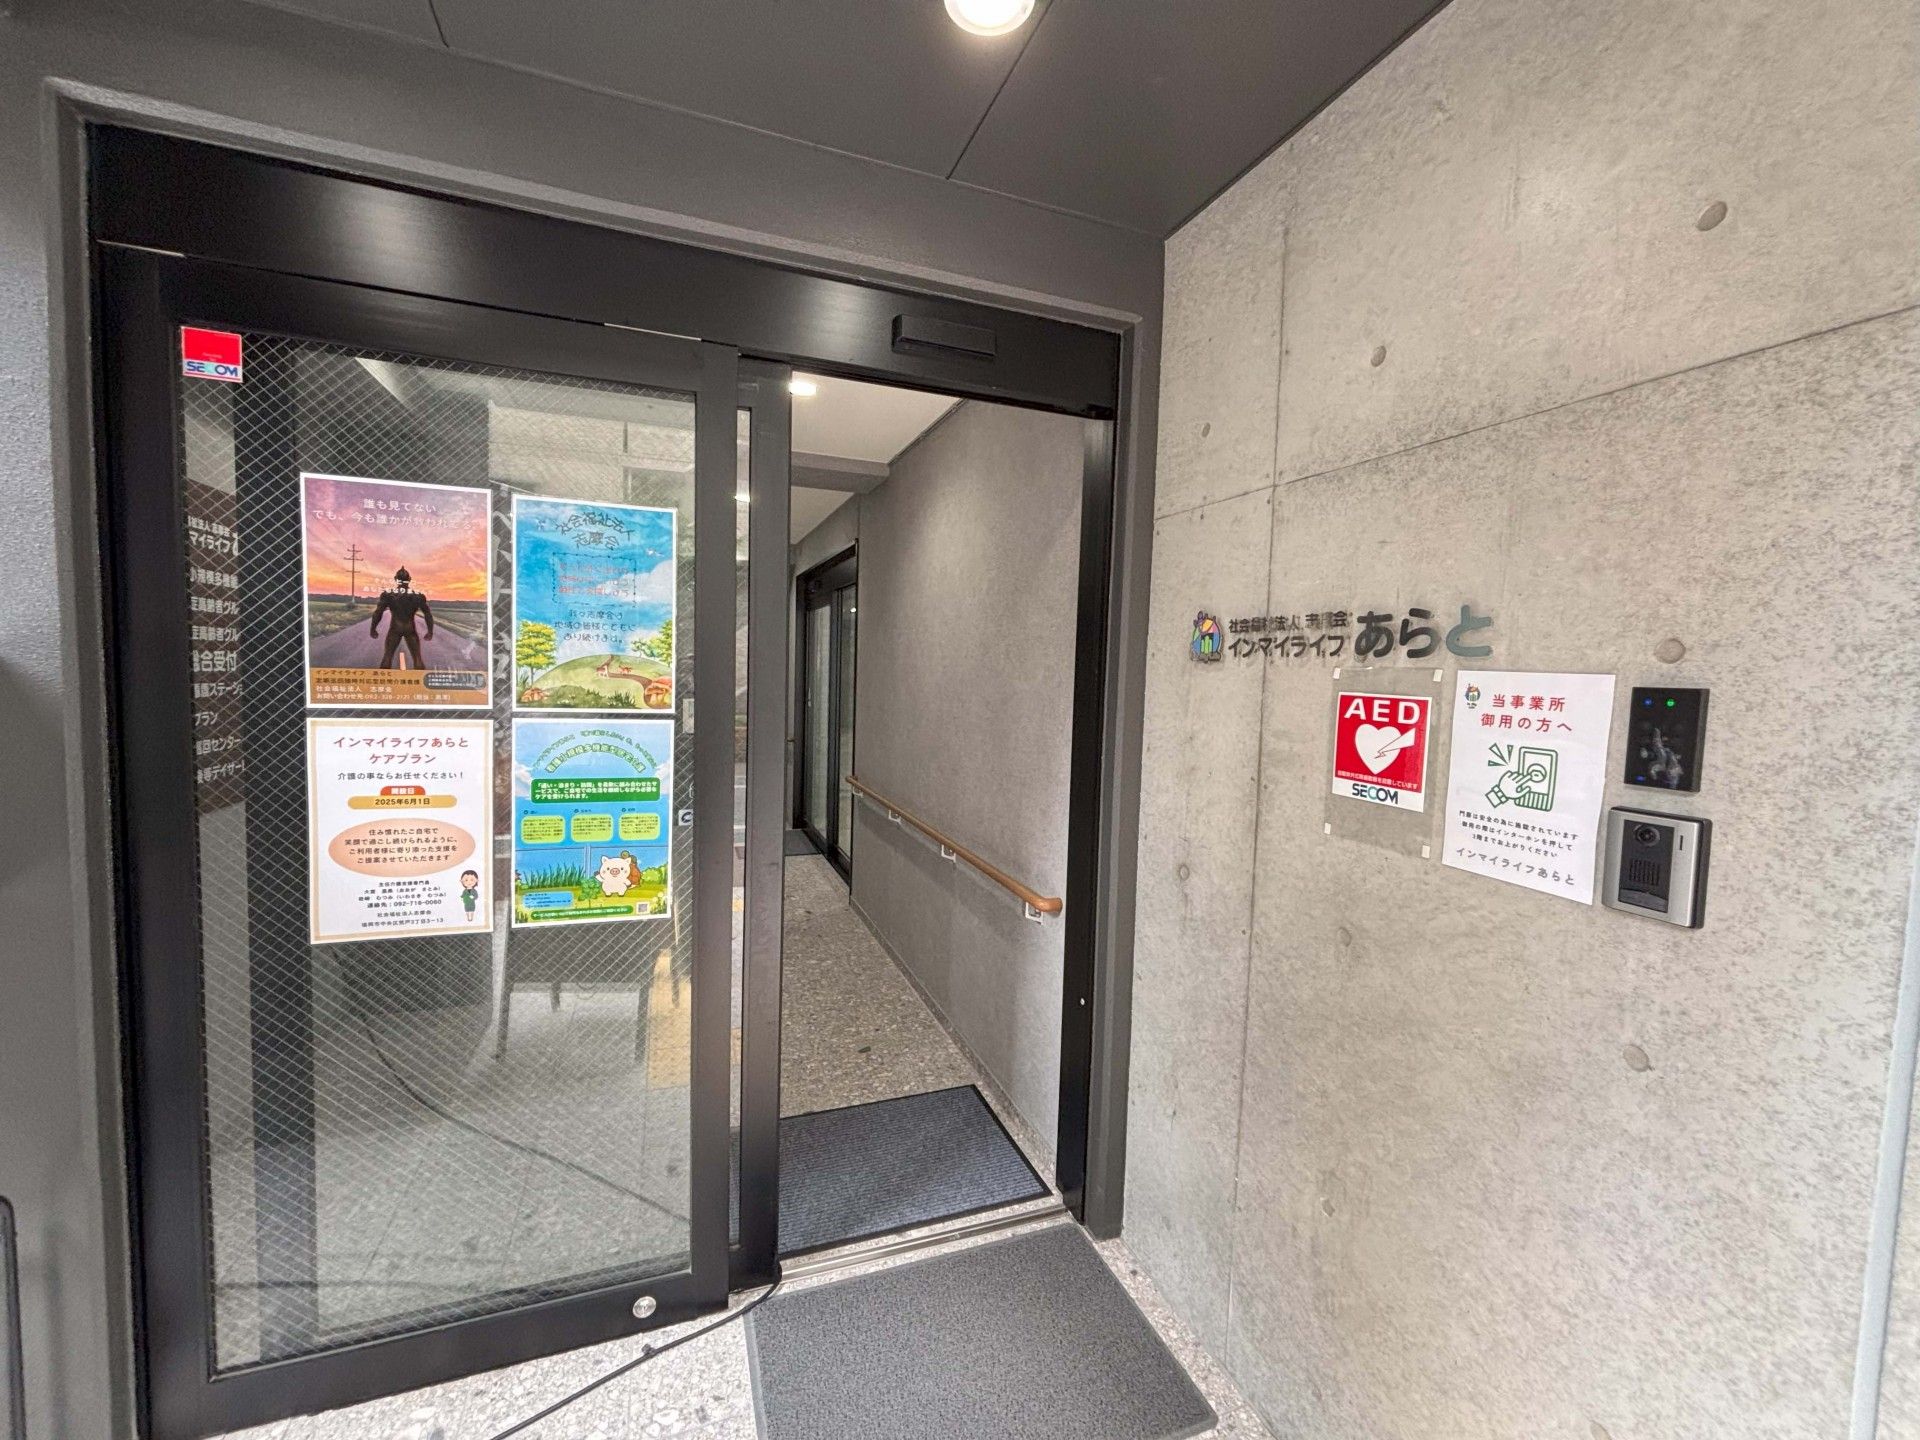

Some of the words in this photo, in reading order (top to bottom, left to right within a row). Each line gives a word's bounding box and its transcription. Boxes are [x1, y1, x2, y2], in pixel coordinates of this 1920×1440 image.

[363, 499, 437, 513] 誰も見てない
[1355, 605, 1493, 658] あらと
[1228, 634, 1344, 658] インマイライフ
[1344, 698, 1421, 725] AED
[1491, 693, 1566, 712] 当事業所
[1480, 713, 1573, 733] 御用の方へ
[333, 737, 469, 749] インマイライフあらと
[369, 753, 436, 765] ケアプラン
[374, 798, 431, 806] 2025年6月1日
[1352, 783, 1399, 805] SECOM
[368, 827, 439, 836] 住み慣れたご自宅で
[1456, 847, 1575, 886] インマイライフあらと
